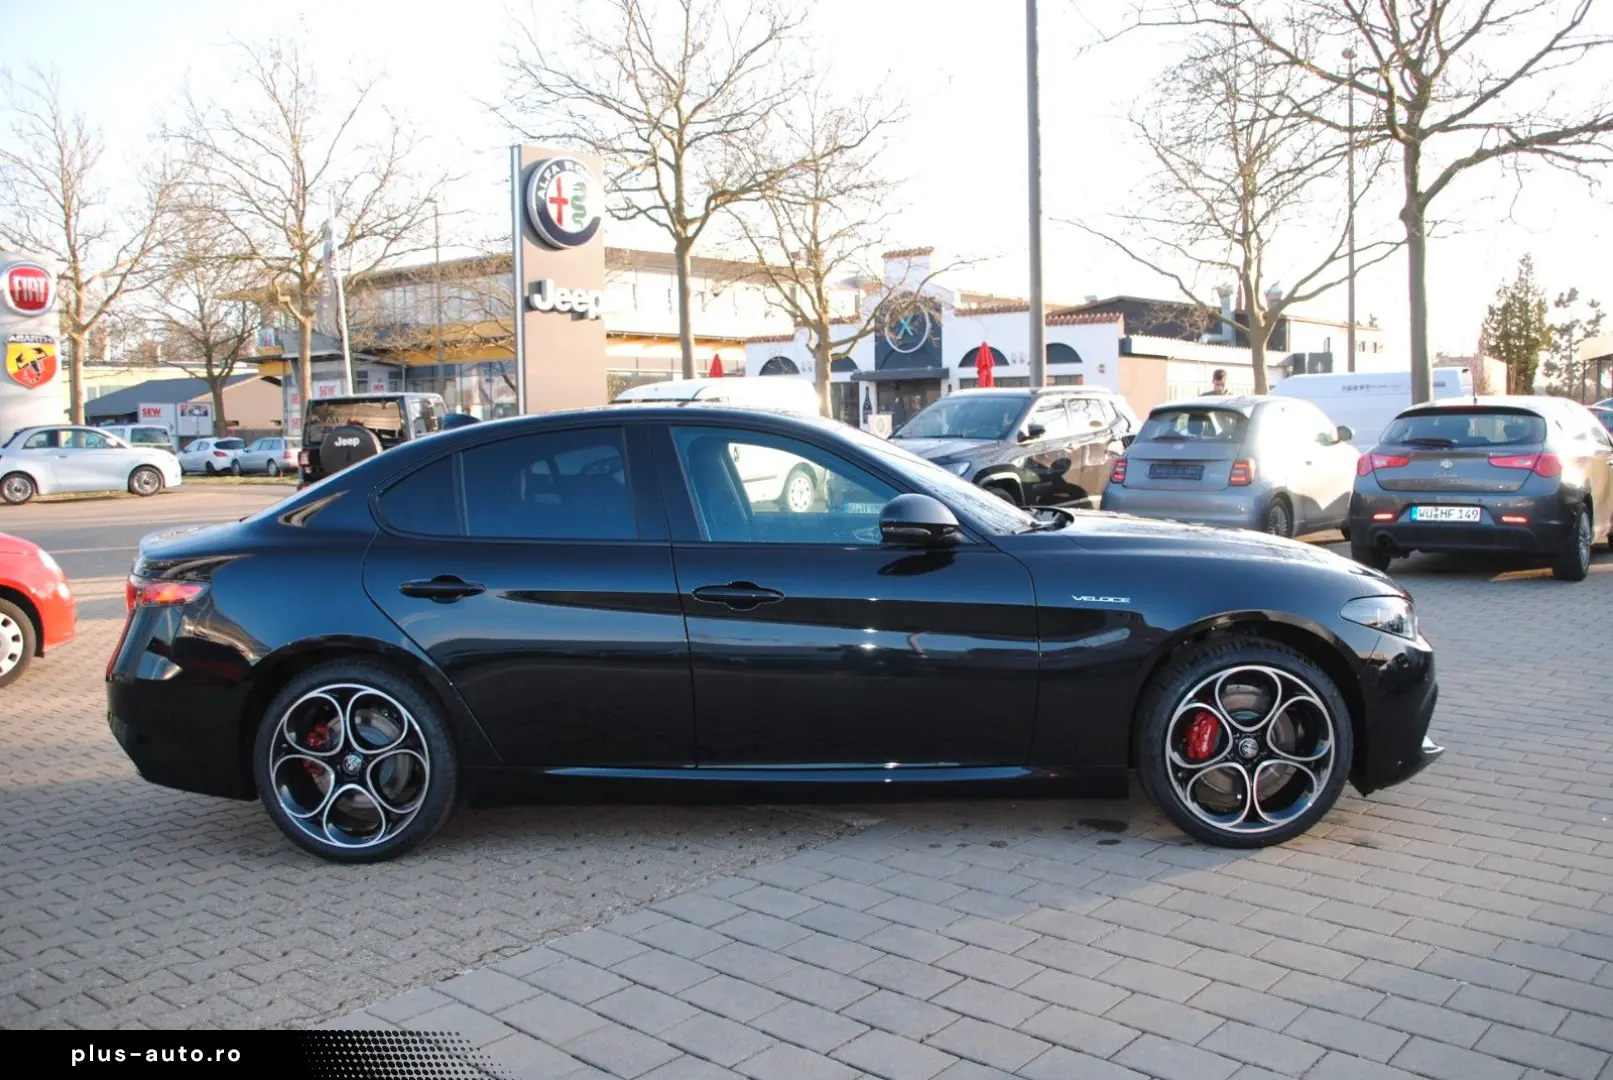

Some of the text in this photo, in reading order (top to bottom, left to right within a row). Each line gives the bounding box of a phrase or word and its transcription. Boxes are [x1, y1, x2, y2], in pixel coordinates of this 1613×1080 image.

[537, 165, 561, 200] ALFA
[13, 275, 47, 302] FIAT
[529, 278, 603, 320] Jeep
[142, 407, 161, 417] SEW
[334, 436, 360, 447] Jeep
[1457, 509, 1479, 520] 149
[1071, 595, 1131, 604] VELOCE
